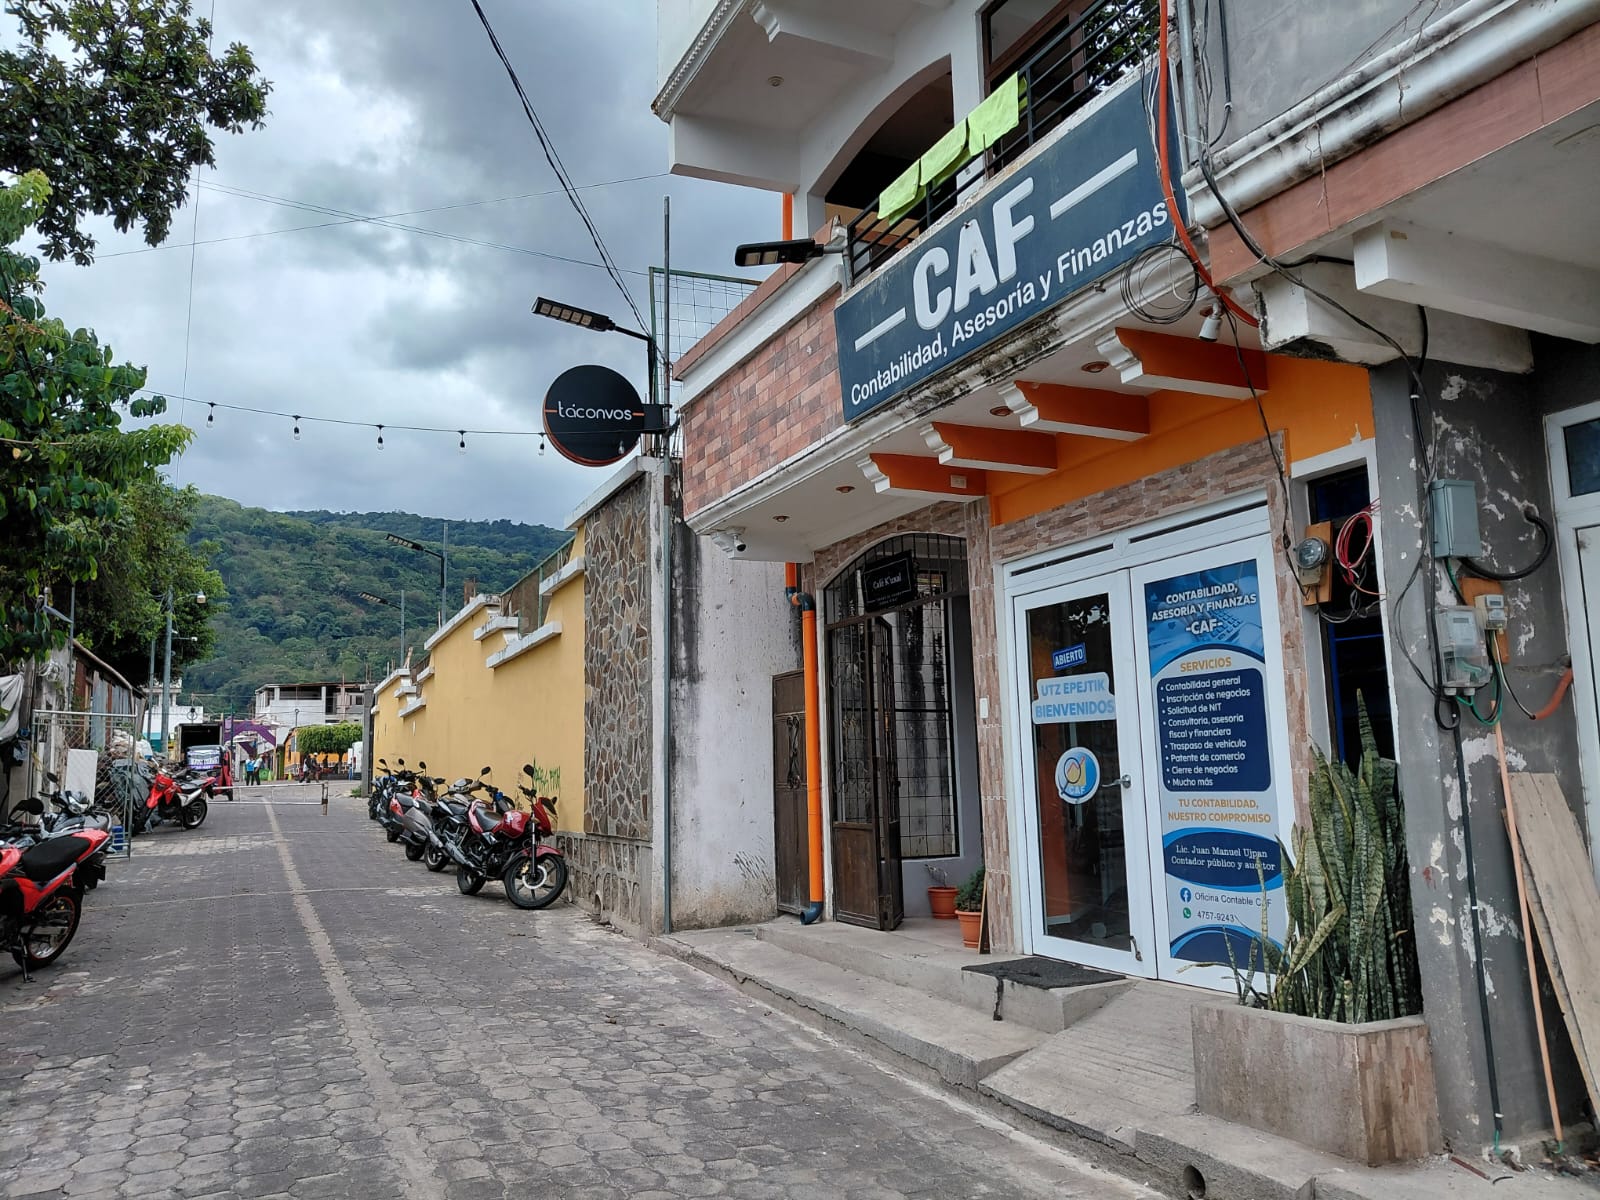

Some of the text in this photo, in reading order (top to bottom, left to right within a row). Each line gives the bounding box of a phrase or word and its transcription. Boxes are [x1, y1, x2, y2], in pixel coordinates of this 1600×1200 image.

[913, 176, 1036, 330] CAF
[851, 201, 1168, 405] Contabilidad, Asesoría y Finanzas
[1166, 583, 1238, 604] CONTABILIDAD,
[1152, 593, 1257, 621] ASESORÍA Y FINANZAS
[1055, 649, 1083, 666] ABIERTO
[1180, 657, 1232, 672] SERVICIOS
[1041, 680, 1105, 696] UTZ EPEJTIK
[1165, 676, 1240, 691] Contabilidad general
[1166, 692, 1204, 703] Inscripción
[1216, 688, 1251, 699] negocios
[1035, 700, 1114, 718] BIENVENIDOS
[1167, 703, 1222, 715] Solicitud de NIT
[1169, 727, 1231, 739] fiscal y financiera
[1170, 742, 1202, 751] Traspaso
[1204, 740, 1213, 748] de
[1171, 751, 1245, 762] Patente de comercio
[1172, 764, 1238, 775] Cierre de negocios
[1172, 777, 1213, 786] Mucho más
[1178, 798, 1259, 809] TU CONTABILIDAD,
[1168, 812, 1271, 823] NUESTRO COMPROMISO
[1176, 845, 1190, 853] Lic.
[1191, 846, 1210, 854] Juan
[1211, 847, 1241, 857] Manuel
[1171, 856, 1205, 866] Contador
[1207, 857, 1236, 869] público
[1237, 862, 1243, 870] y
[1194, 892, 1272, 907] Oficina Contable CF
[1197, 911, 1234, 922] 4757-9243
